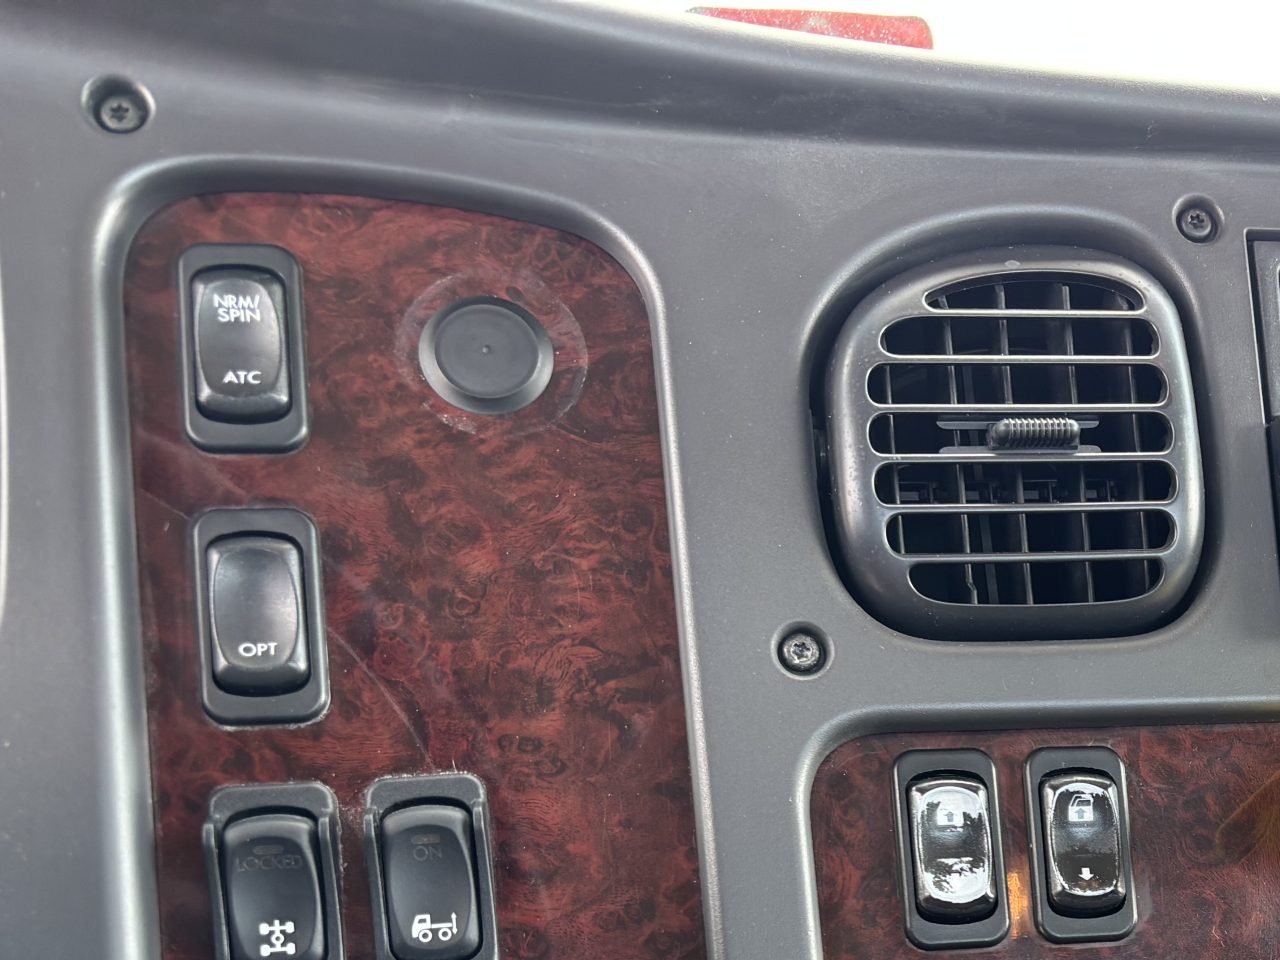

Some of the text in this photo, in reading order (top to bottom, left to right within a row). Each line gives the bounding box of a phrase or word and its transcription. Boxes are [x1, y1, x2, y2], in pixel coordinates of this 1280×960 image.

[213, 294, 260, 309] NRM/
[217, 306, 261, 322] SPIN
[222, 369, 262, 385] ATC
[237, 641, 278, 657] OPT
[413, 845, 443, 861] ON
